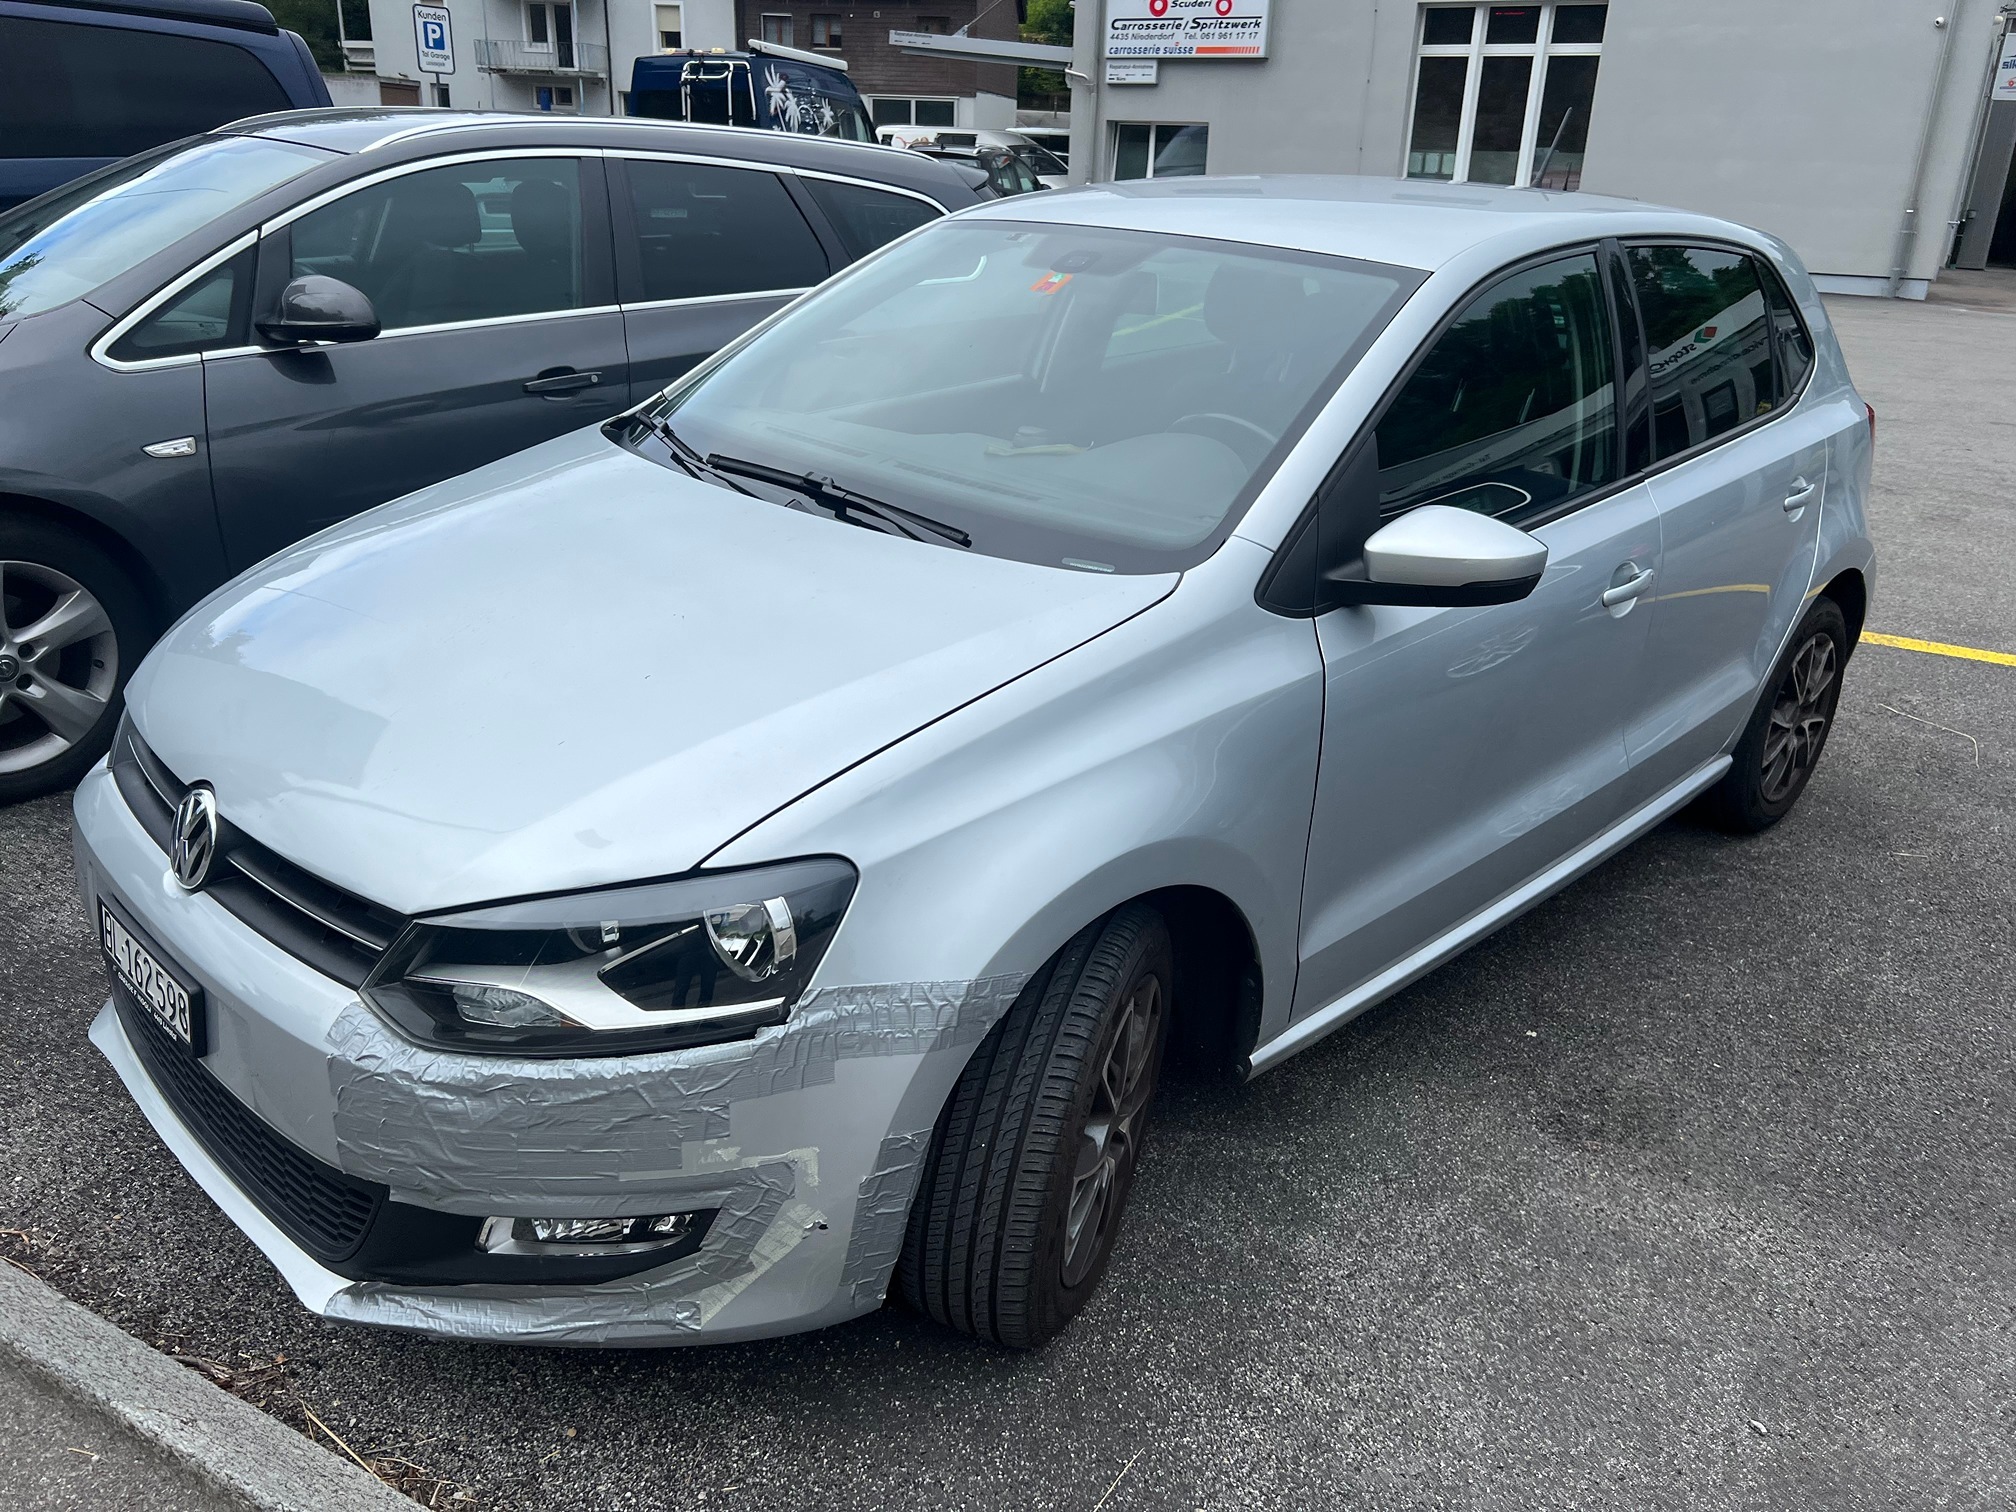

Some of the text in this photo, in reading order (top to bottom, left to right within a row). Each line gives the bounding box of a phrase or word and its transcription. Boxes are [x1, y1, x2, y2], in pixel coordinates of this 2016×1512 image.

[1170, 0, 1212, 8] Scuderi
[417, 10, 447, 21] Kunden
[427, 24, 441, 48] P
[1131, 32, 1175, 41] Niederdorf
[1200, 32, 1216, 40] 061
[1218, 32, 1233, 40] 961
[1108, 42, 1194, 55] carrosserie suisse
[430, 52, 450, 61] Garage
